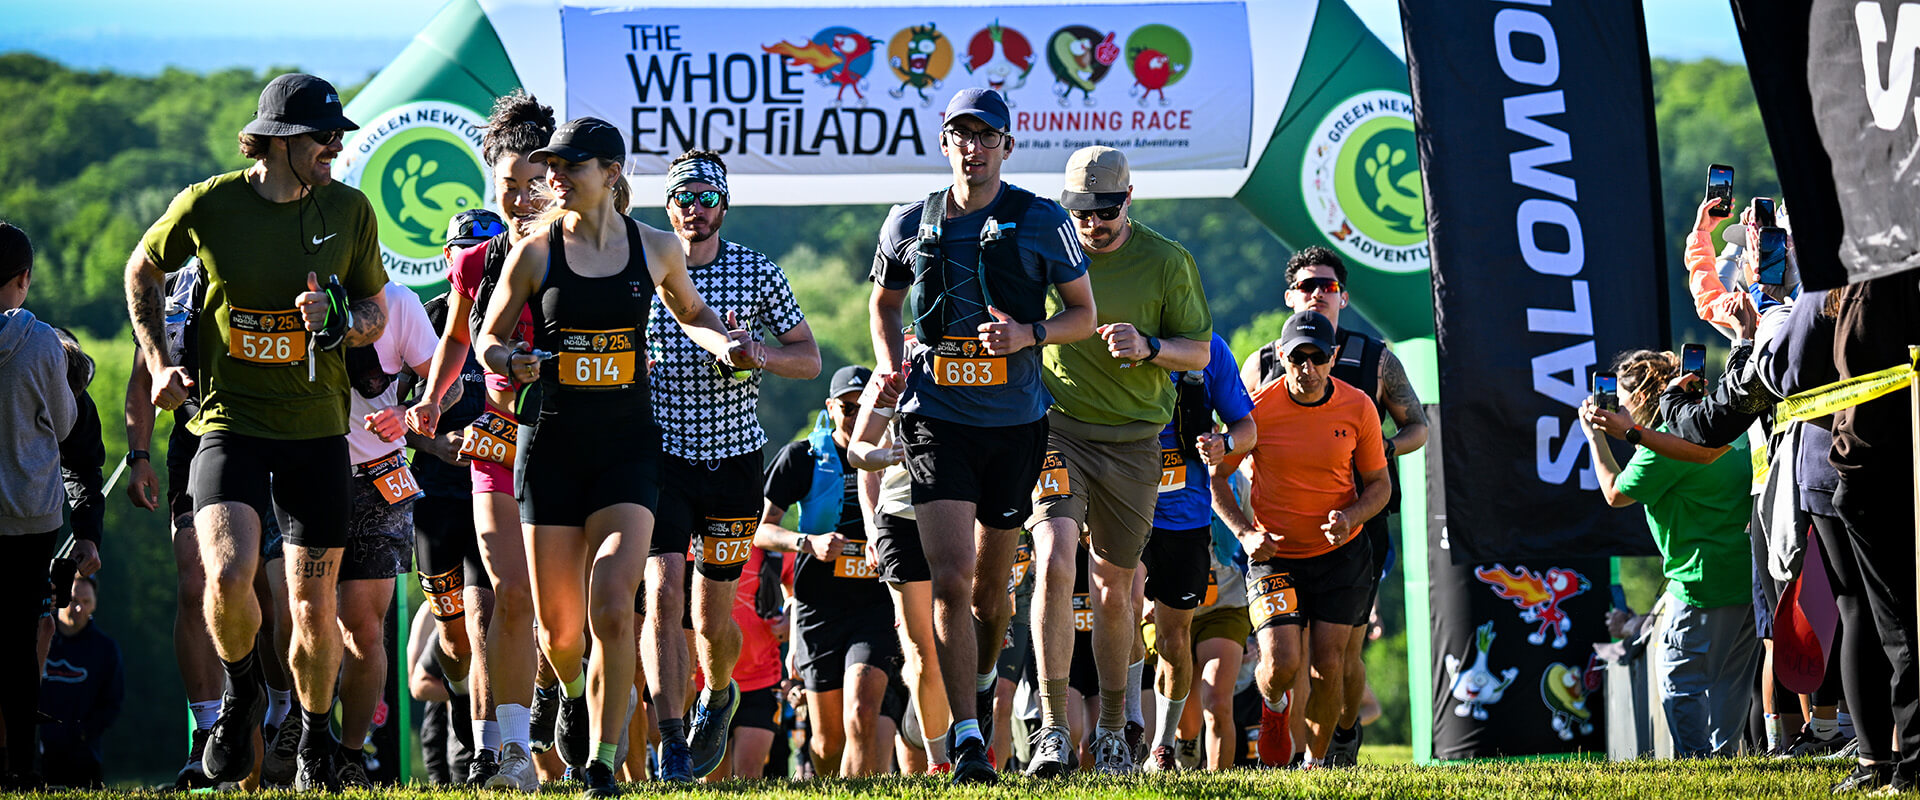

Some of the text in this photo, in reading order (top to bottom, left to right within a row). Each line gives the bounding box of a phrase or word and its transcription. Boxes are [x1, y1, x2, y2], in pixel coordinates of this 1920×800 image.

[623, 24, 681, 51] THE
[626, 53, 805, 104] WHOLE
[359, 109, 484, 153] GREEN NEWTON
[1017, 109, 1193, 132] RUNNING RACE
[1328, 102, 1374, 143] GREEN
[1494, 0, 1599, 490] SALOMO
[381, 251, 449, 276] DVENTU
[242, 335, 291, 360] 526
[576, 357, 620, 382] 614
[946, 361, 993, 384] 683
[461, 430, 507, 463] 669
[715, 539, 752, 562] 673
